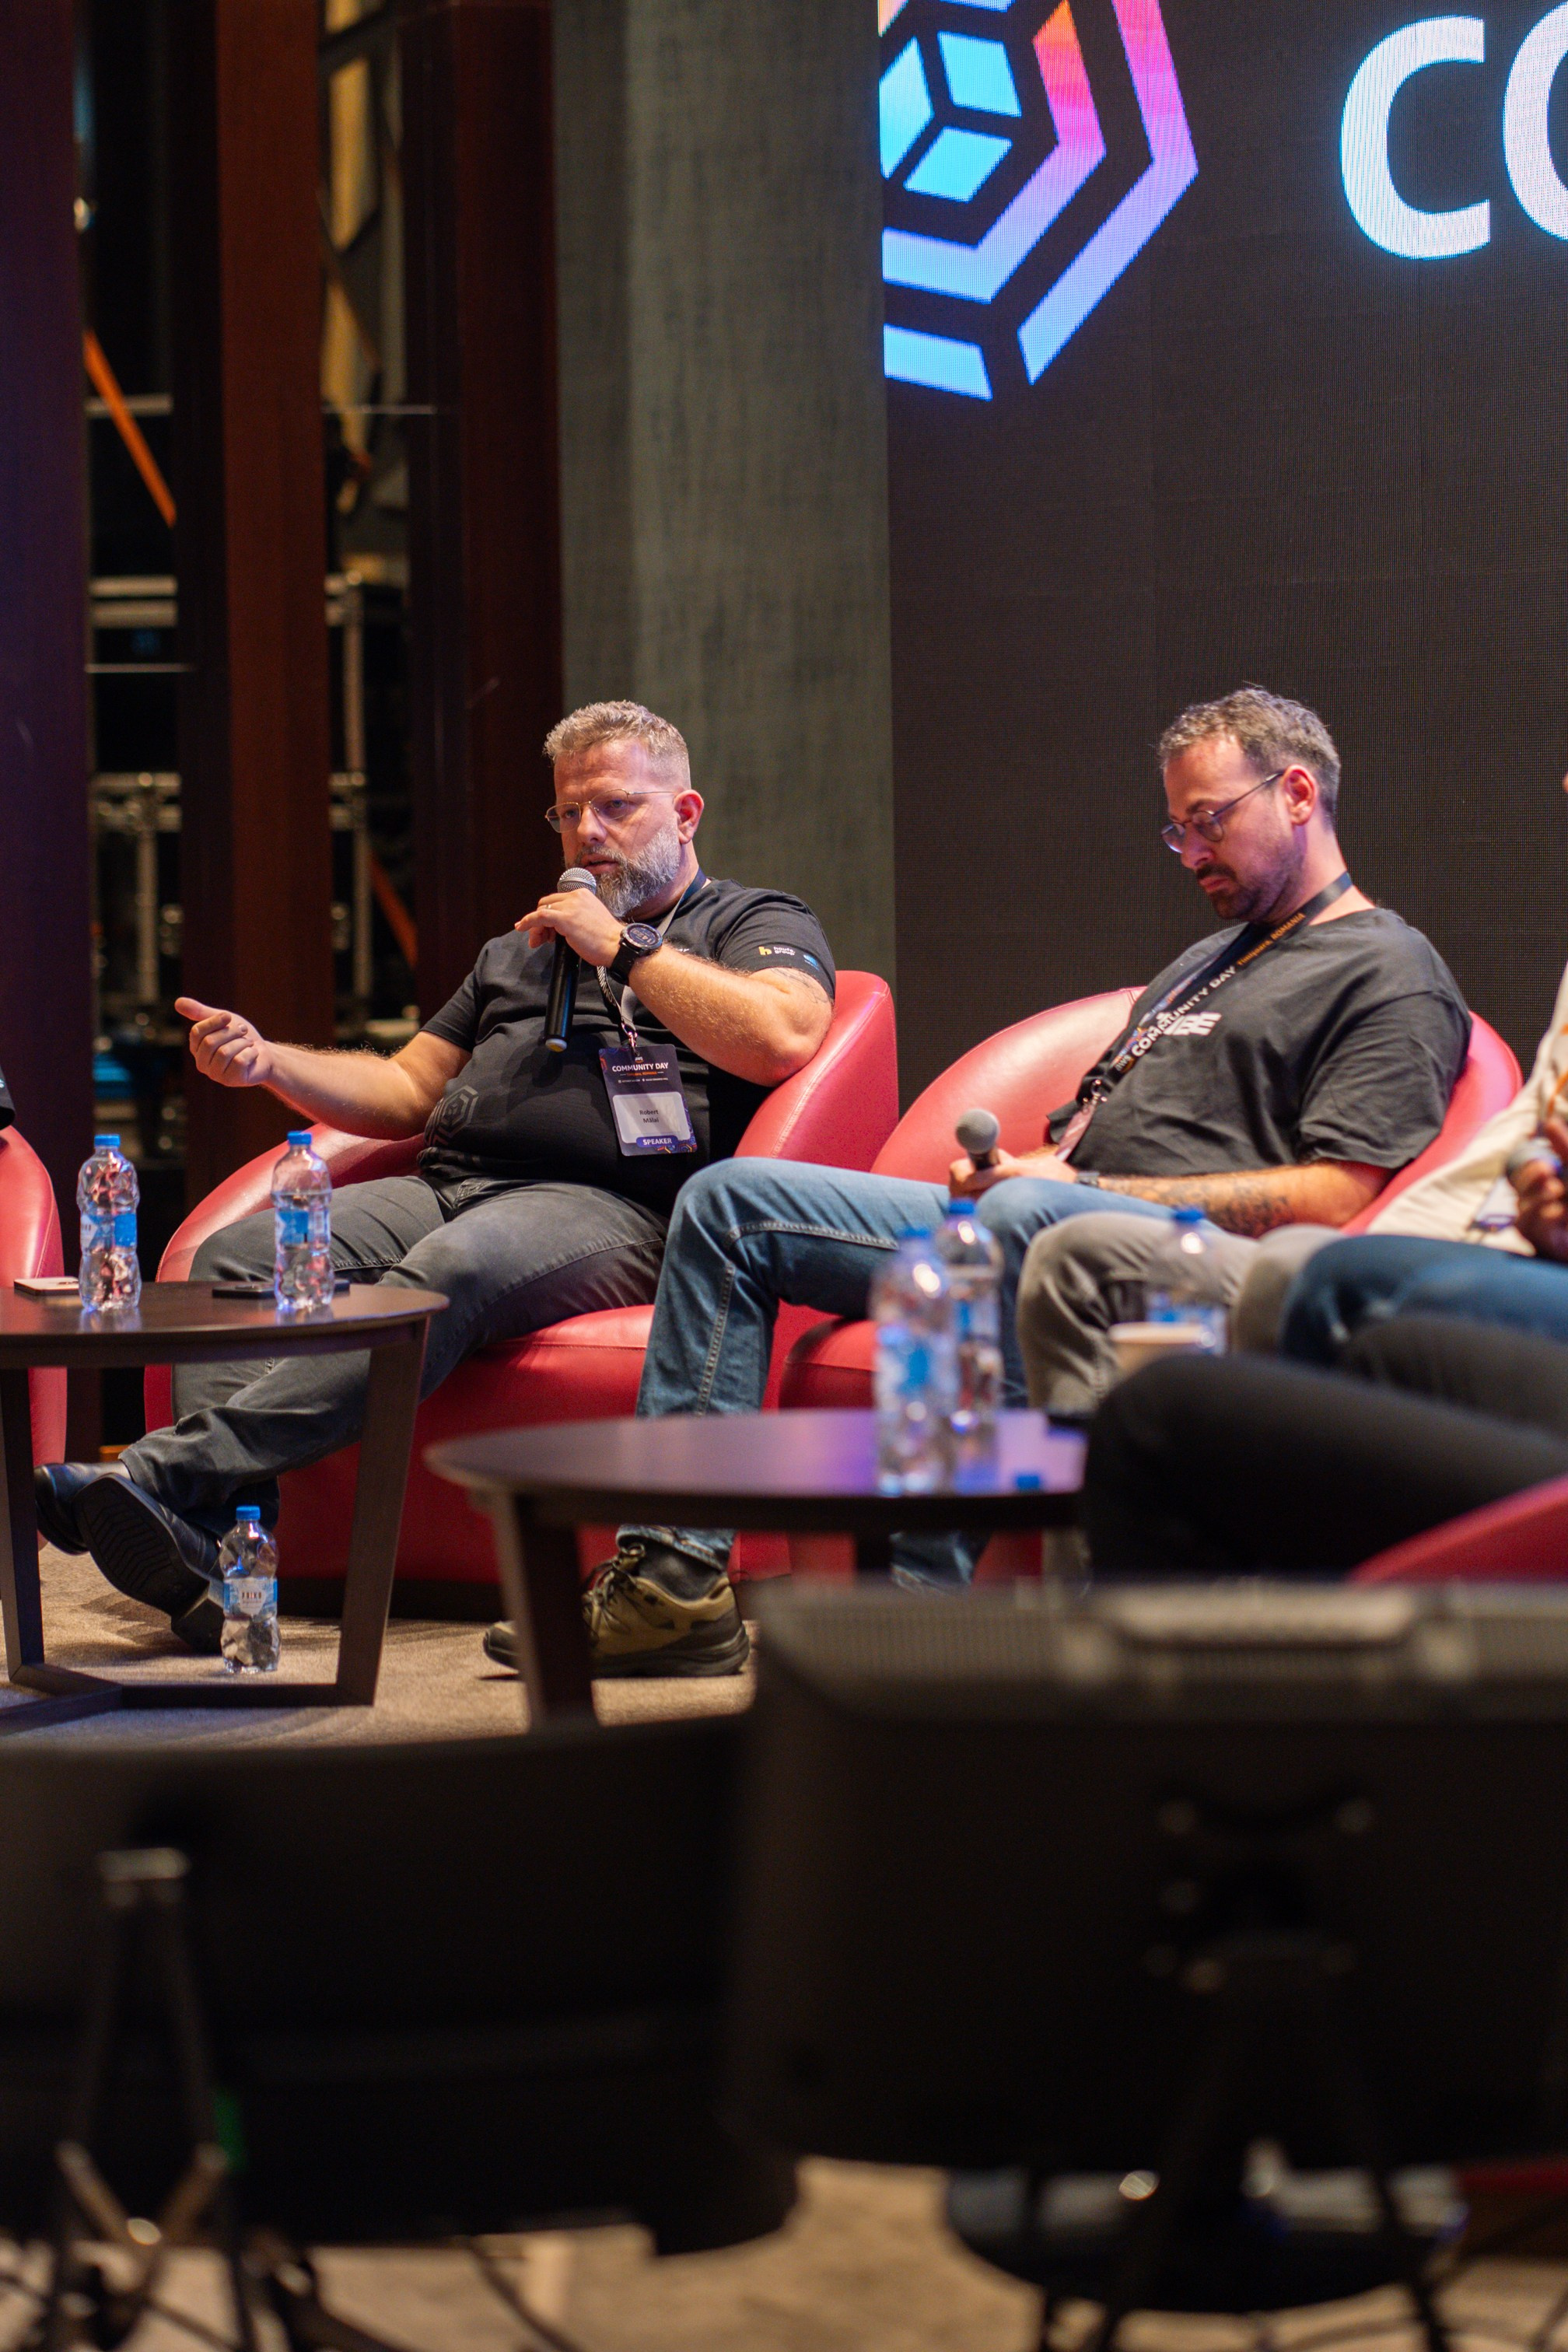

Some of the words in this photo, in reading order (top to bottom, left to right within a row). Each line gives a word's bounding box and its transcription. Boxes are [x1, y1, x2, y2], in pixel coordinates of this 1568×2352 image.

[1132, 987, 1209, 1057] COMMUNITY
[1209, 965, 1236, 989] DAY
[1270, 912, 1306, 940] ROMANIA
[612, 1063, 654, 1072] COMMUNITY
[642, 1137, 672, 1146] SPEAKER
